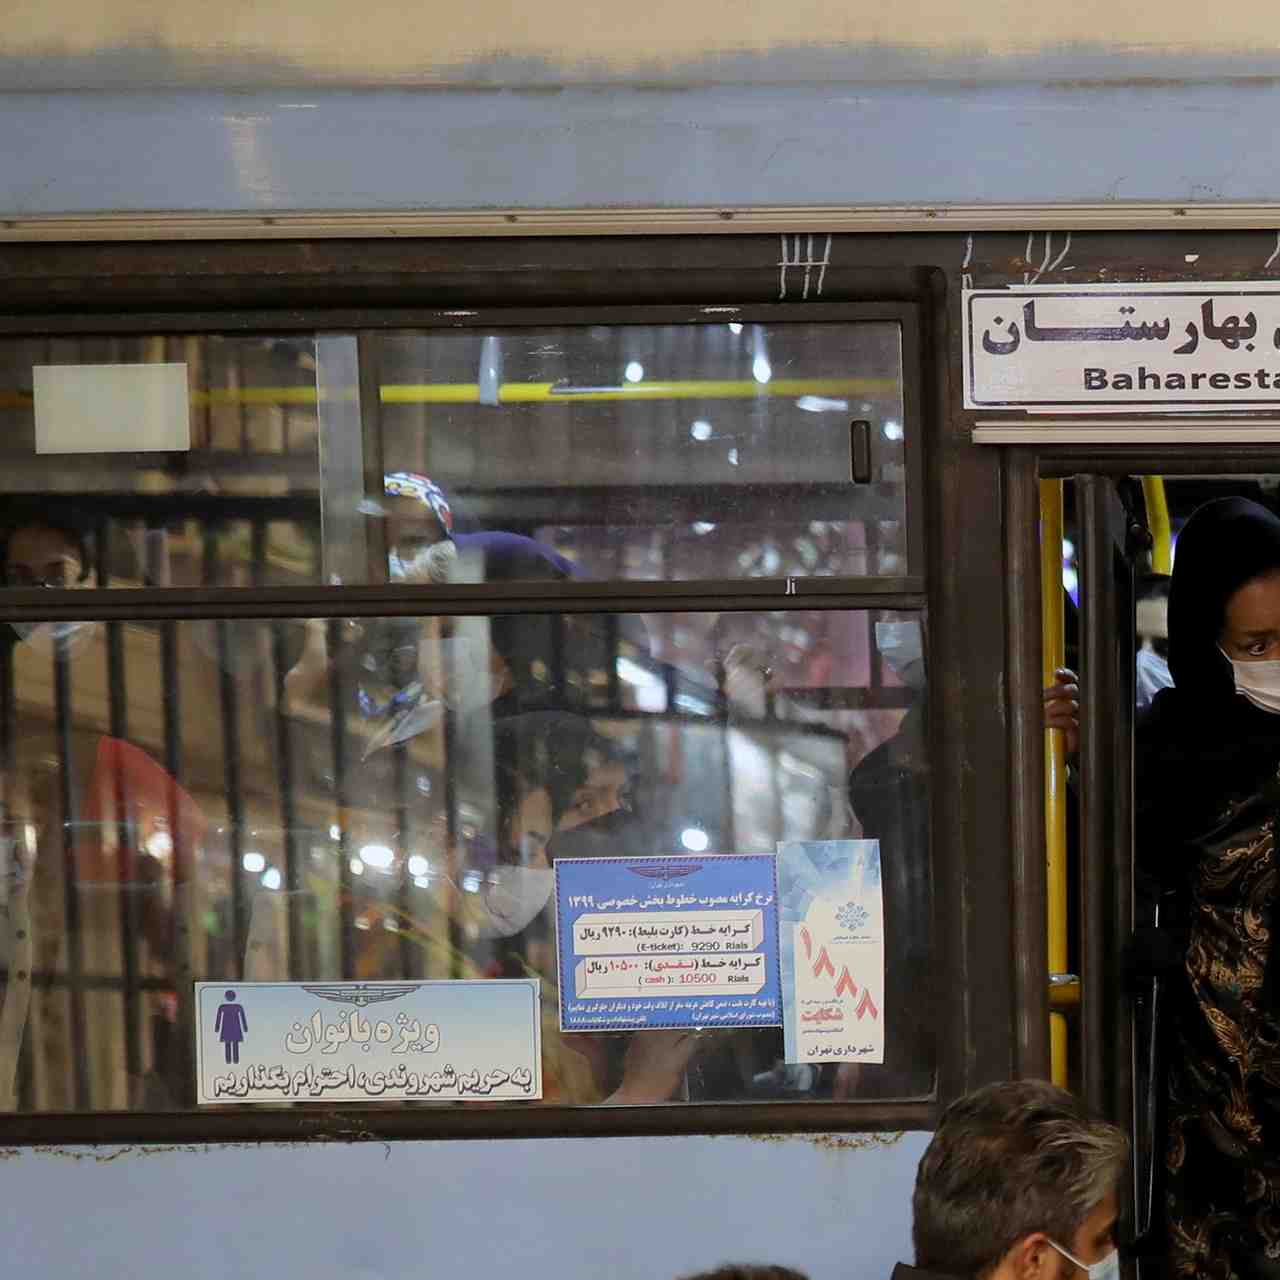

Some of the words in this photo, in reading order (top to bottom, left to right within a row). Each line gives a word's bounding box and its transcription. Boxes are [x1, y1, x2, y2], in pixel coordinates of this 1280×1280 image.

[981, 298, 1258, 355] بهارستان
[690, 941, 721, 951] 9290
[679, 973, 717, 984] 10500
[285, 1008, 372, 1055] بانوان
[374, 1011, 441, 1055] ویژه
[213, 1064, 291, 1098] بگذاریم
[292, 1063, 356, 1097] احترام
[456, 1068, 510, 1096] حریم
[510, 1065, 532, 1094] به
